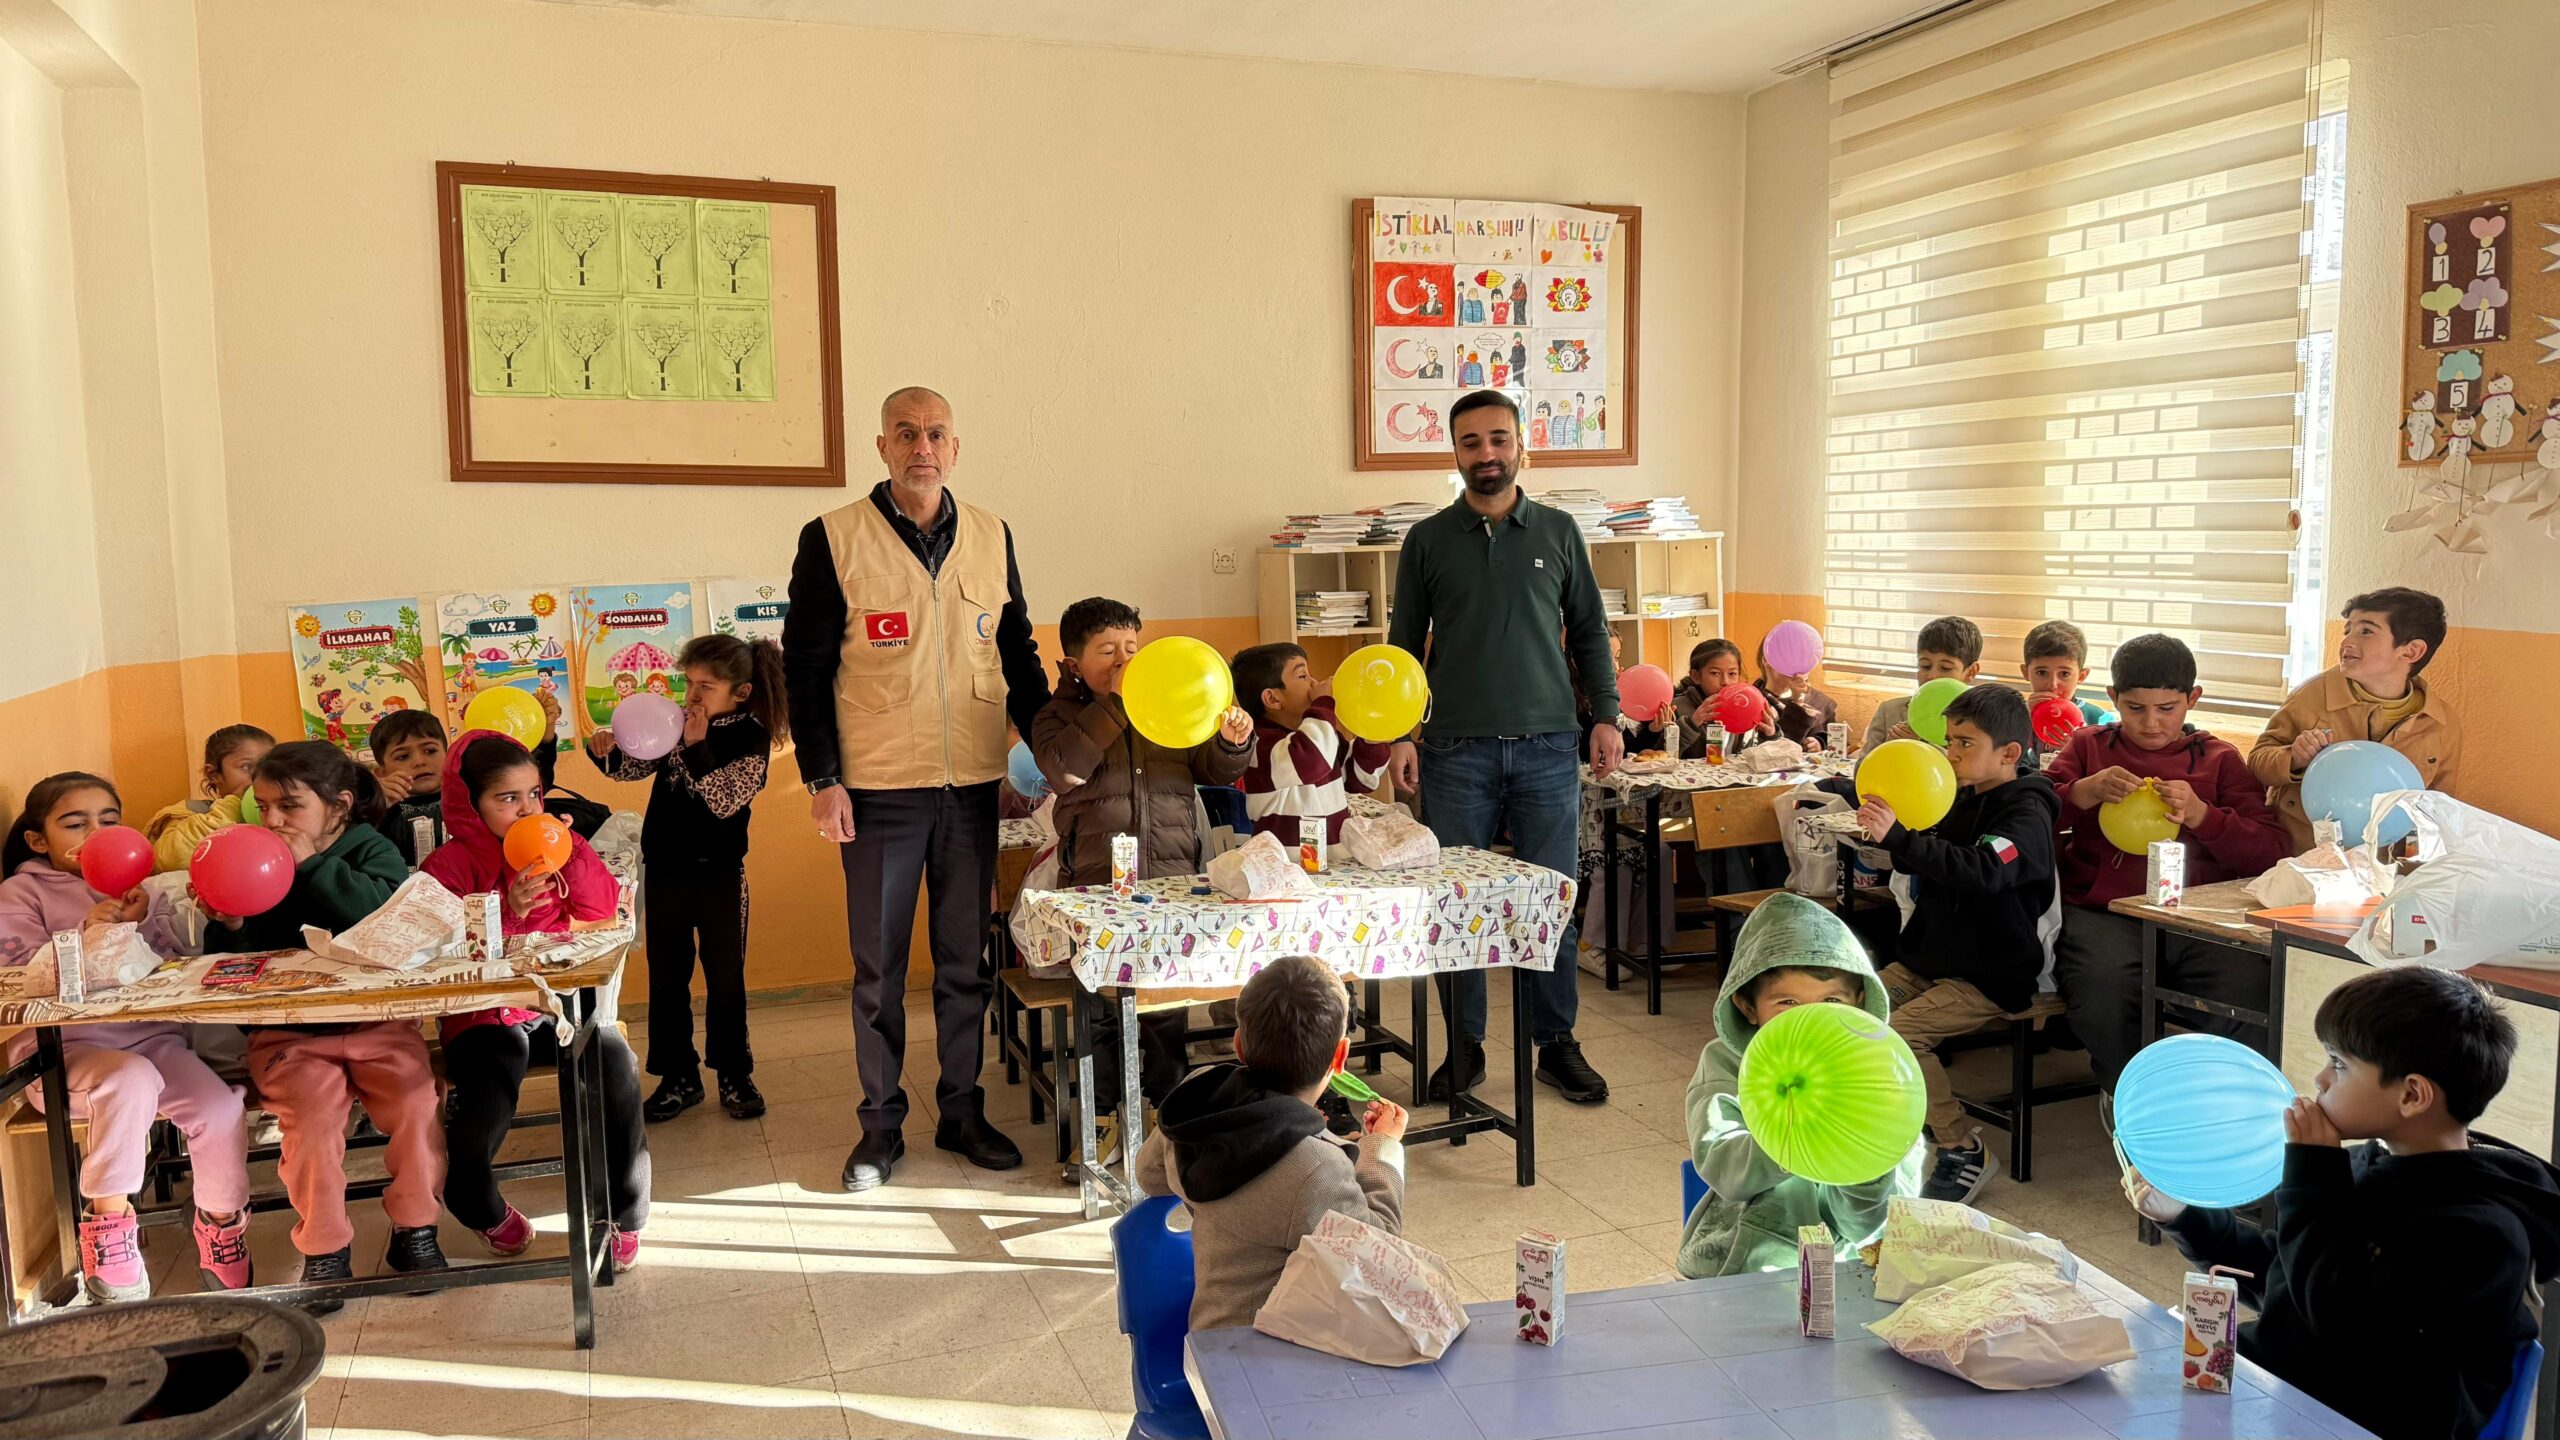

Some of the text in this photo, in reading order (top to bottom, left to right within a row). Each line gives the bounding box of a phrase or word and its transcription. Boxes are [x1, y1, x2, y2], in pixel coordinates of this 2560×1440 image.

[1376, 211, 1452, 236] İSTİKLAL
[2438, 250, 2494, 280] 1 2
[2436, 311, 2493, 341] 3 4
[2452, 385, 2465, 407] 5
[488, 621, 517, 633] YAZ
[605, 613, 664, 624] SONBAHAR
[326, 631, 391, 645] İLKBAHAR
[869, 638, 910, 648] TÜRKİYE
